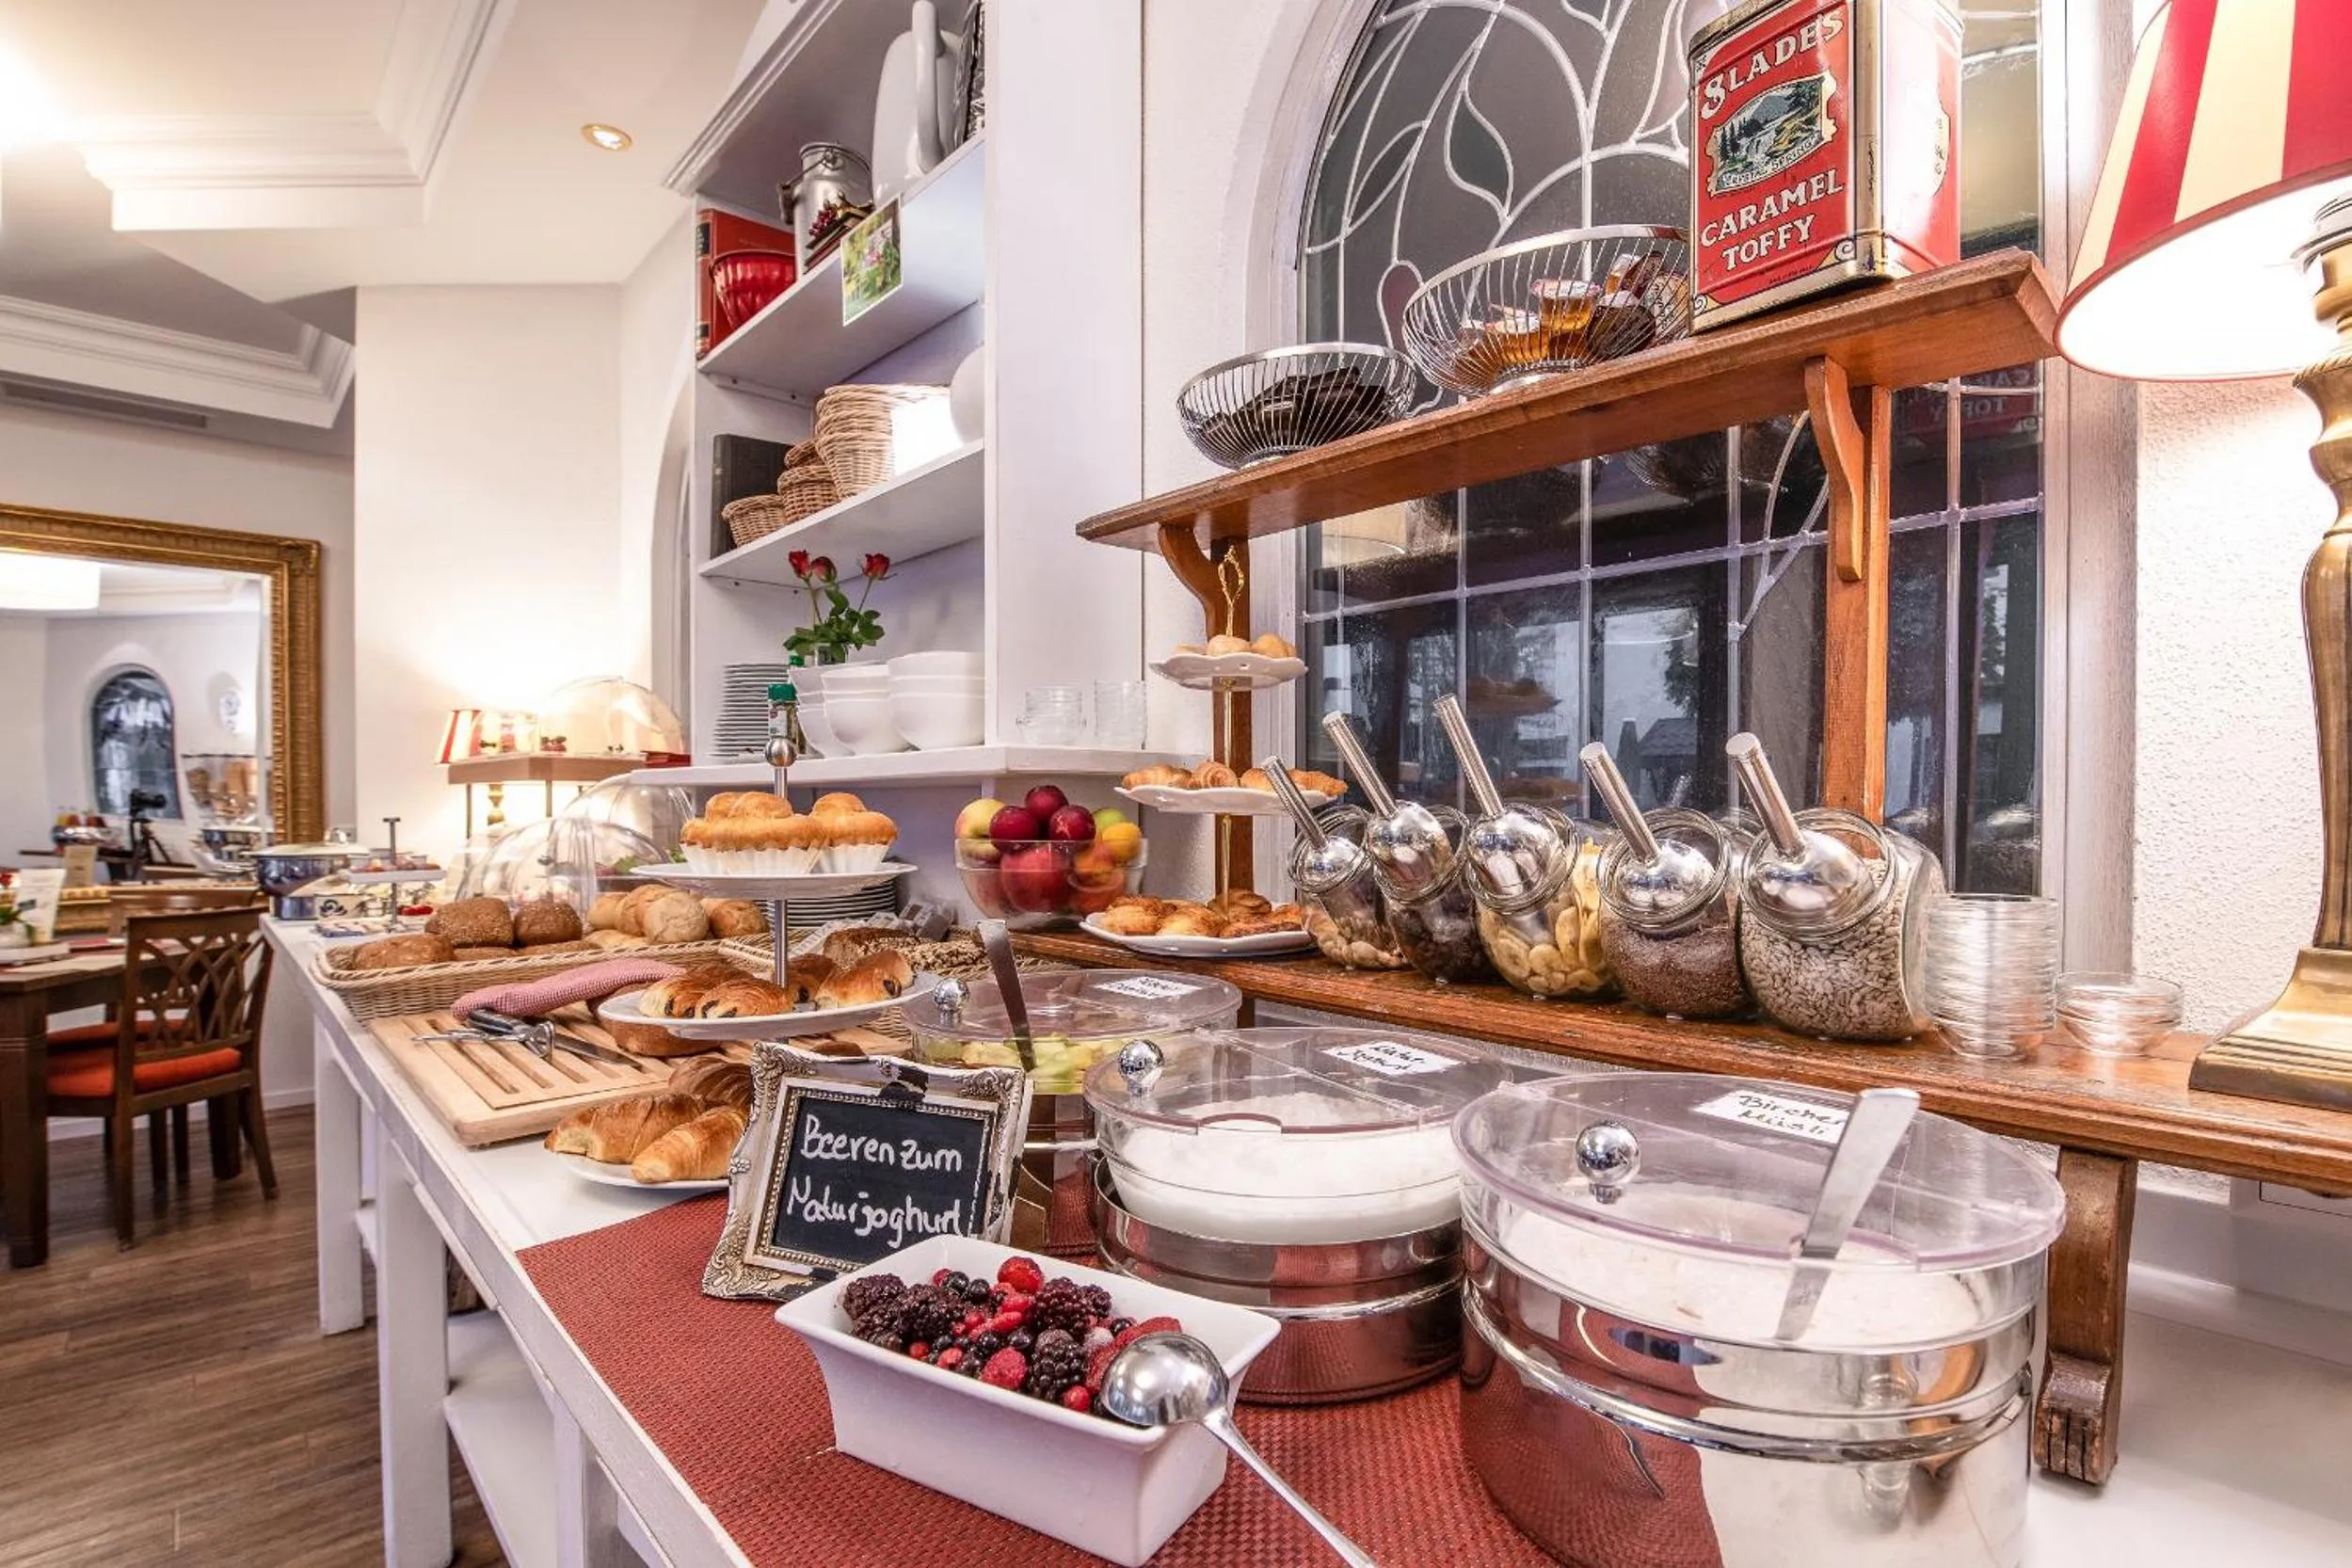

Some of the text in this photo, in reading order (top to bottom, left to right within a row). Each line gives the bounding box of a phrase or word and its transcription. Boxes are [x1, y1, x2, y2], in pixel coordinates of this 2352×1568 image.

[1700, 12, 1845, 120] SLADE'S
[1700, 169, 1845, 247] CARAMEL
[1722, 214, 1816, 271] TOFFY
[799, 1112, 895, 1166] Beeren
